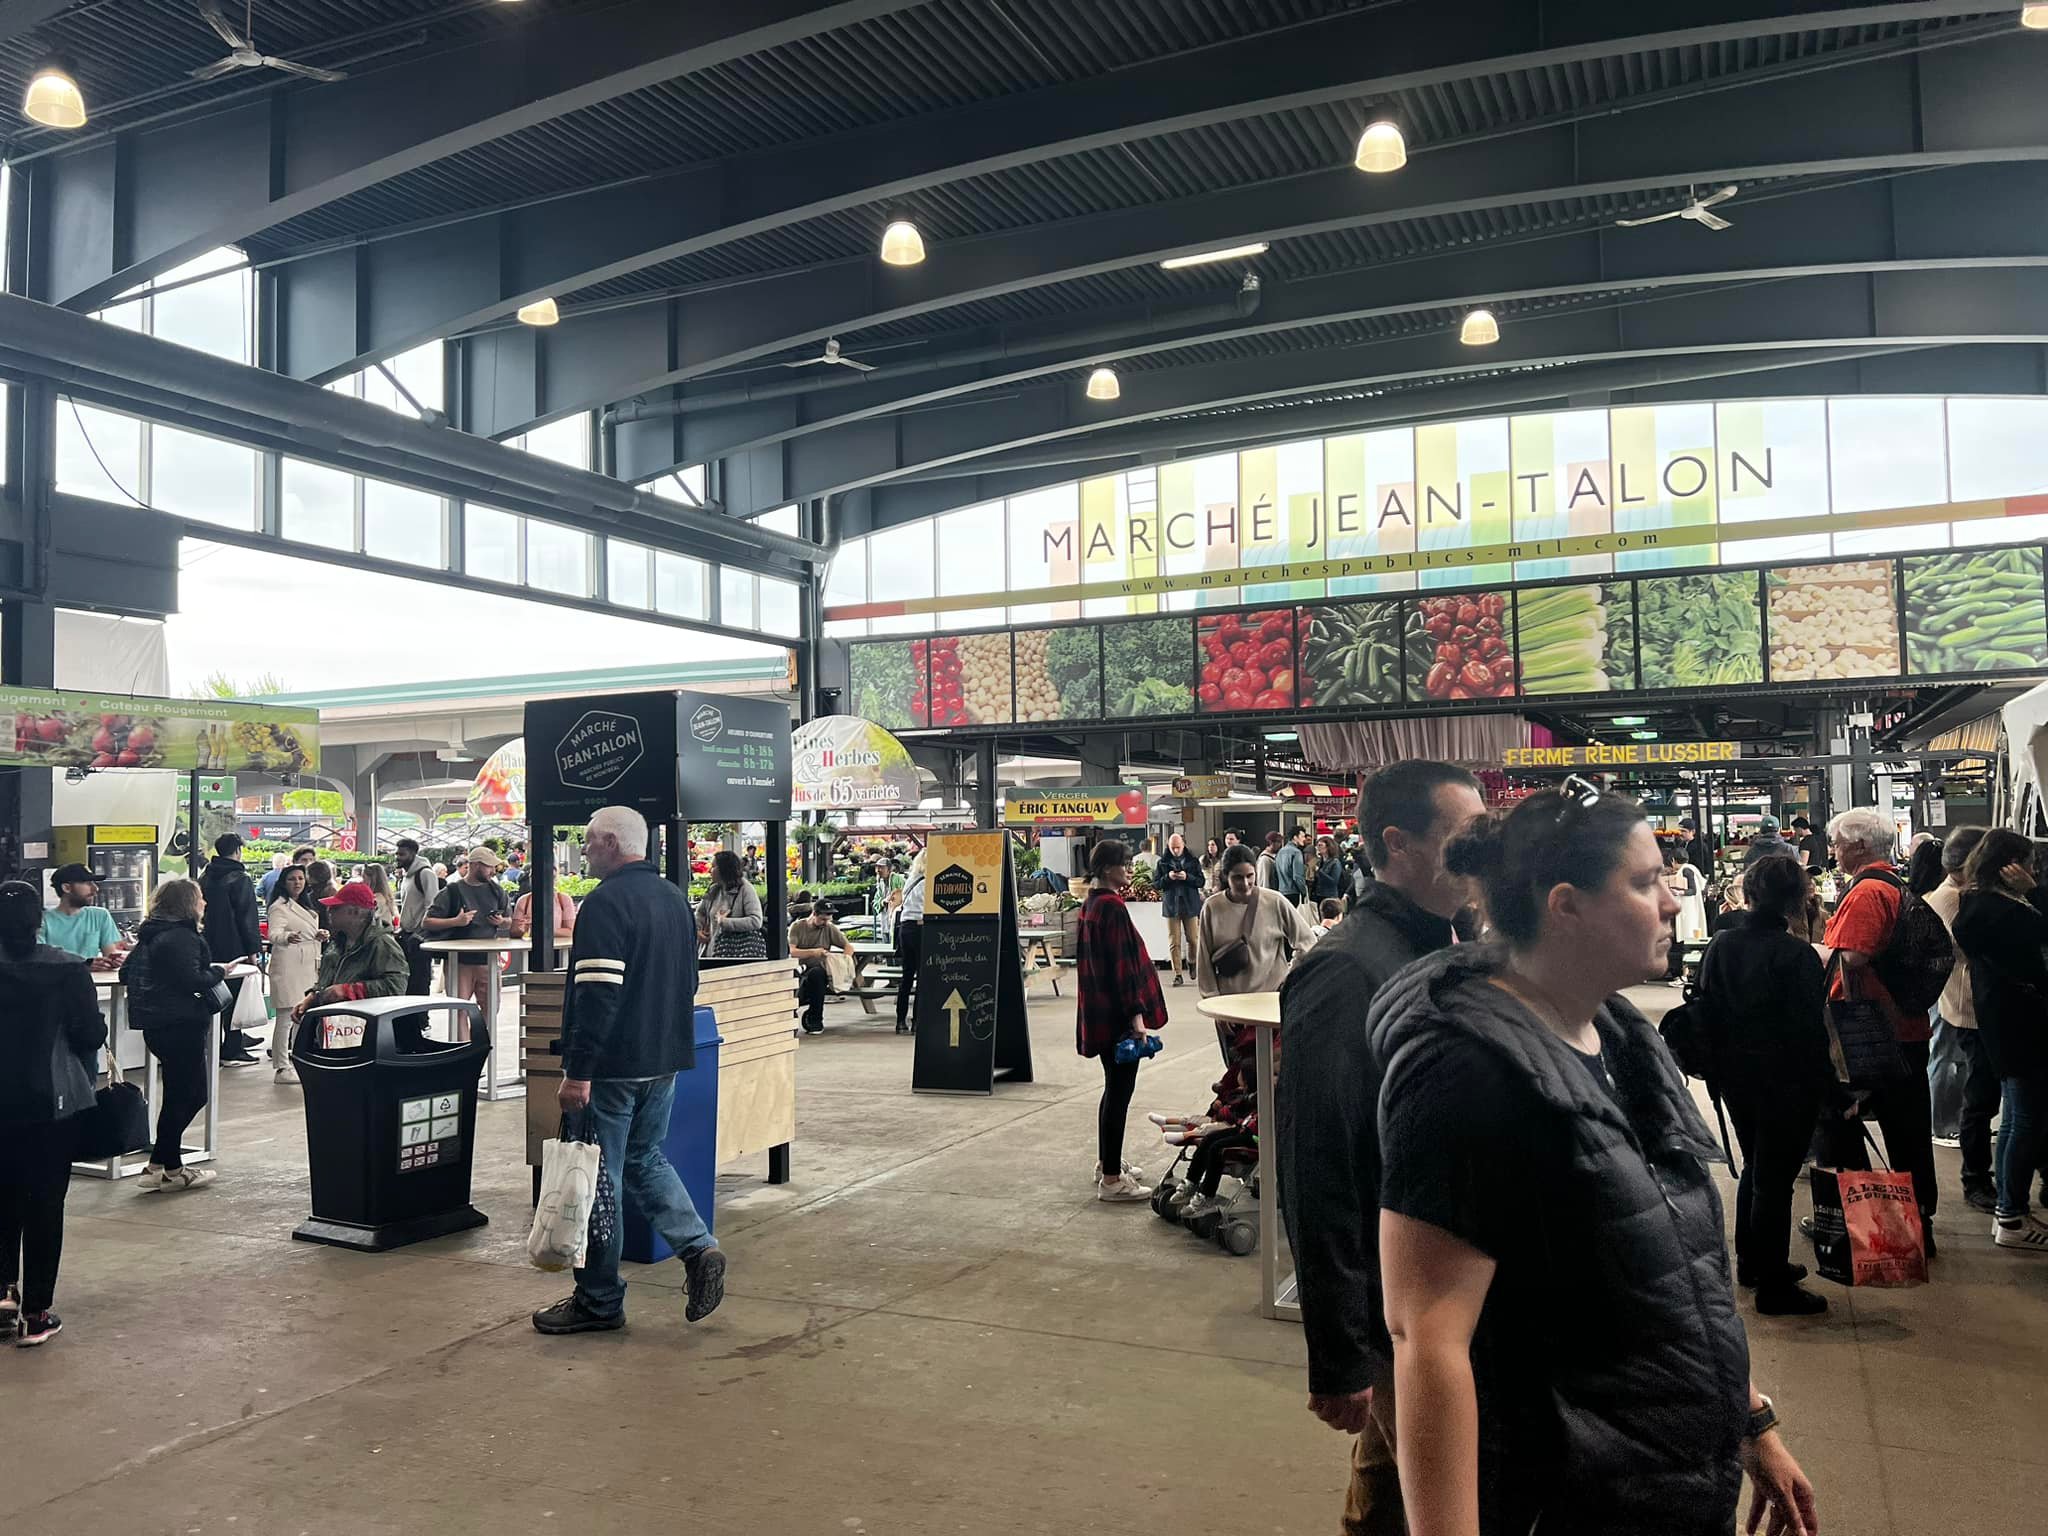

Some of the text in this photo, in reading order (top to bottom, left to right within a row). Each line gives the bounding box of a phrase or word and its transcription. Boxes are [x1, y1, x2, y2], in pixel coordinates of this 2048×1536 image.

[1043, 447, 1773, 563] MARCHÉ JEAN-TALON
[1121, 532, 1658, 592] www.marchespublics-mtl.com
[99, 699, 229, 718] Coteau Rougemont
[570, 719, 617, 747] MARCHÉ
[561, 730, 637, 770] JEAN-TALON
[822, 749, 881, 768] Herbes
[1506, 747, 1576, 766] FERME
[1646, 741, 1735, 763] LUSSIER
[791, 776, 901, 805] lus de 65 variétés
[1039, 791, 1089, 800] VERGER
[1306, 796, 1356, 804] FLEURISTE
[1019, 801, 1109, 815] ÉRIC TANGUAY
